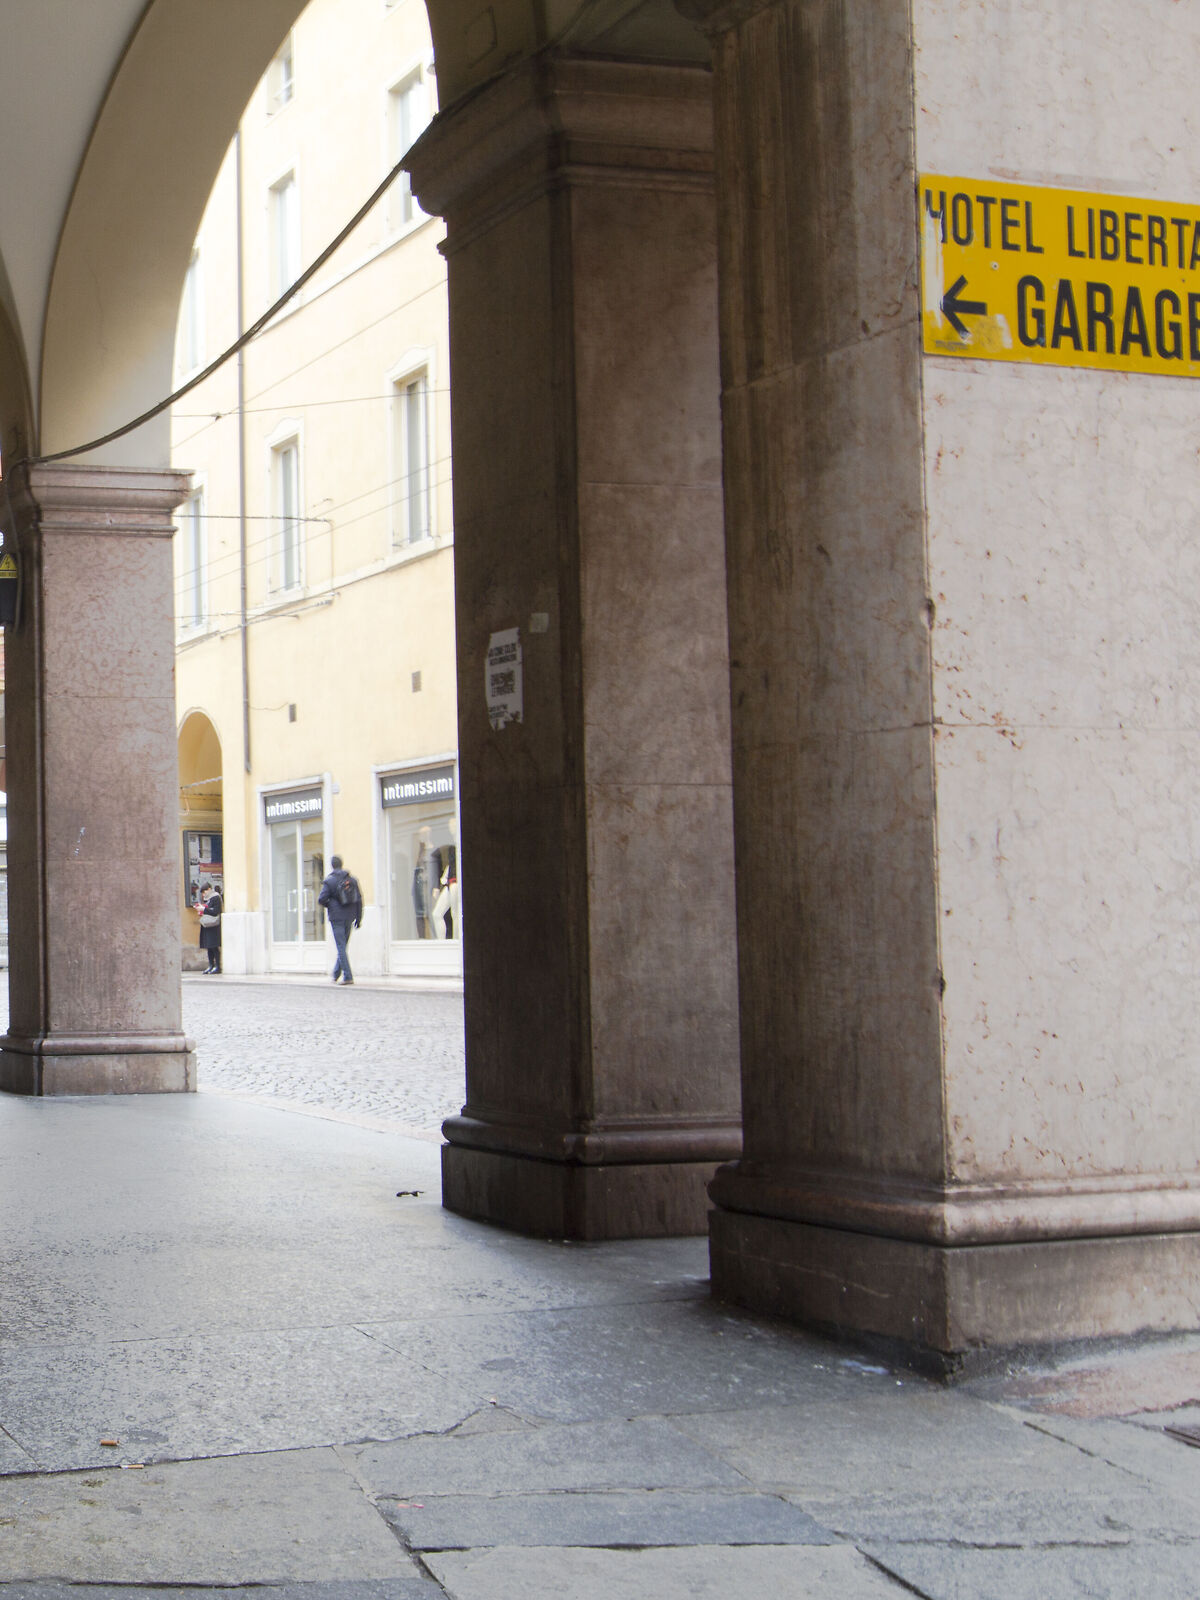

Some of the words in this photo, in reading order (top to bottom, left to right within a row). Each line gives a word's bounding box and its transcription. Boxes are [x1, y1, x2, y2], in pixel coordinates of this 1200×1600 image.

[925, 189, 1044, 254] HOTEL
[384, 777, 453, 801] intimissimi
[266, 798, 322, 817] intimissimi
